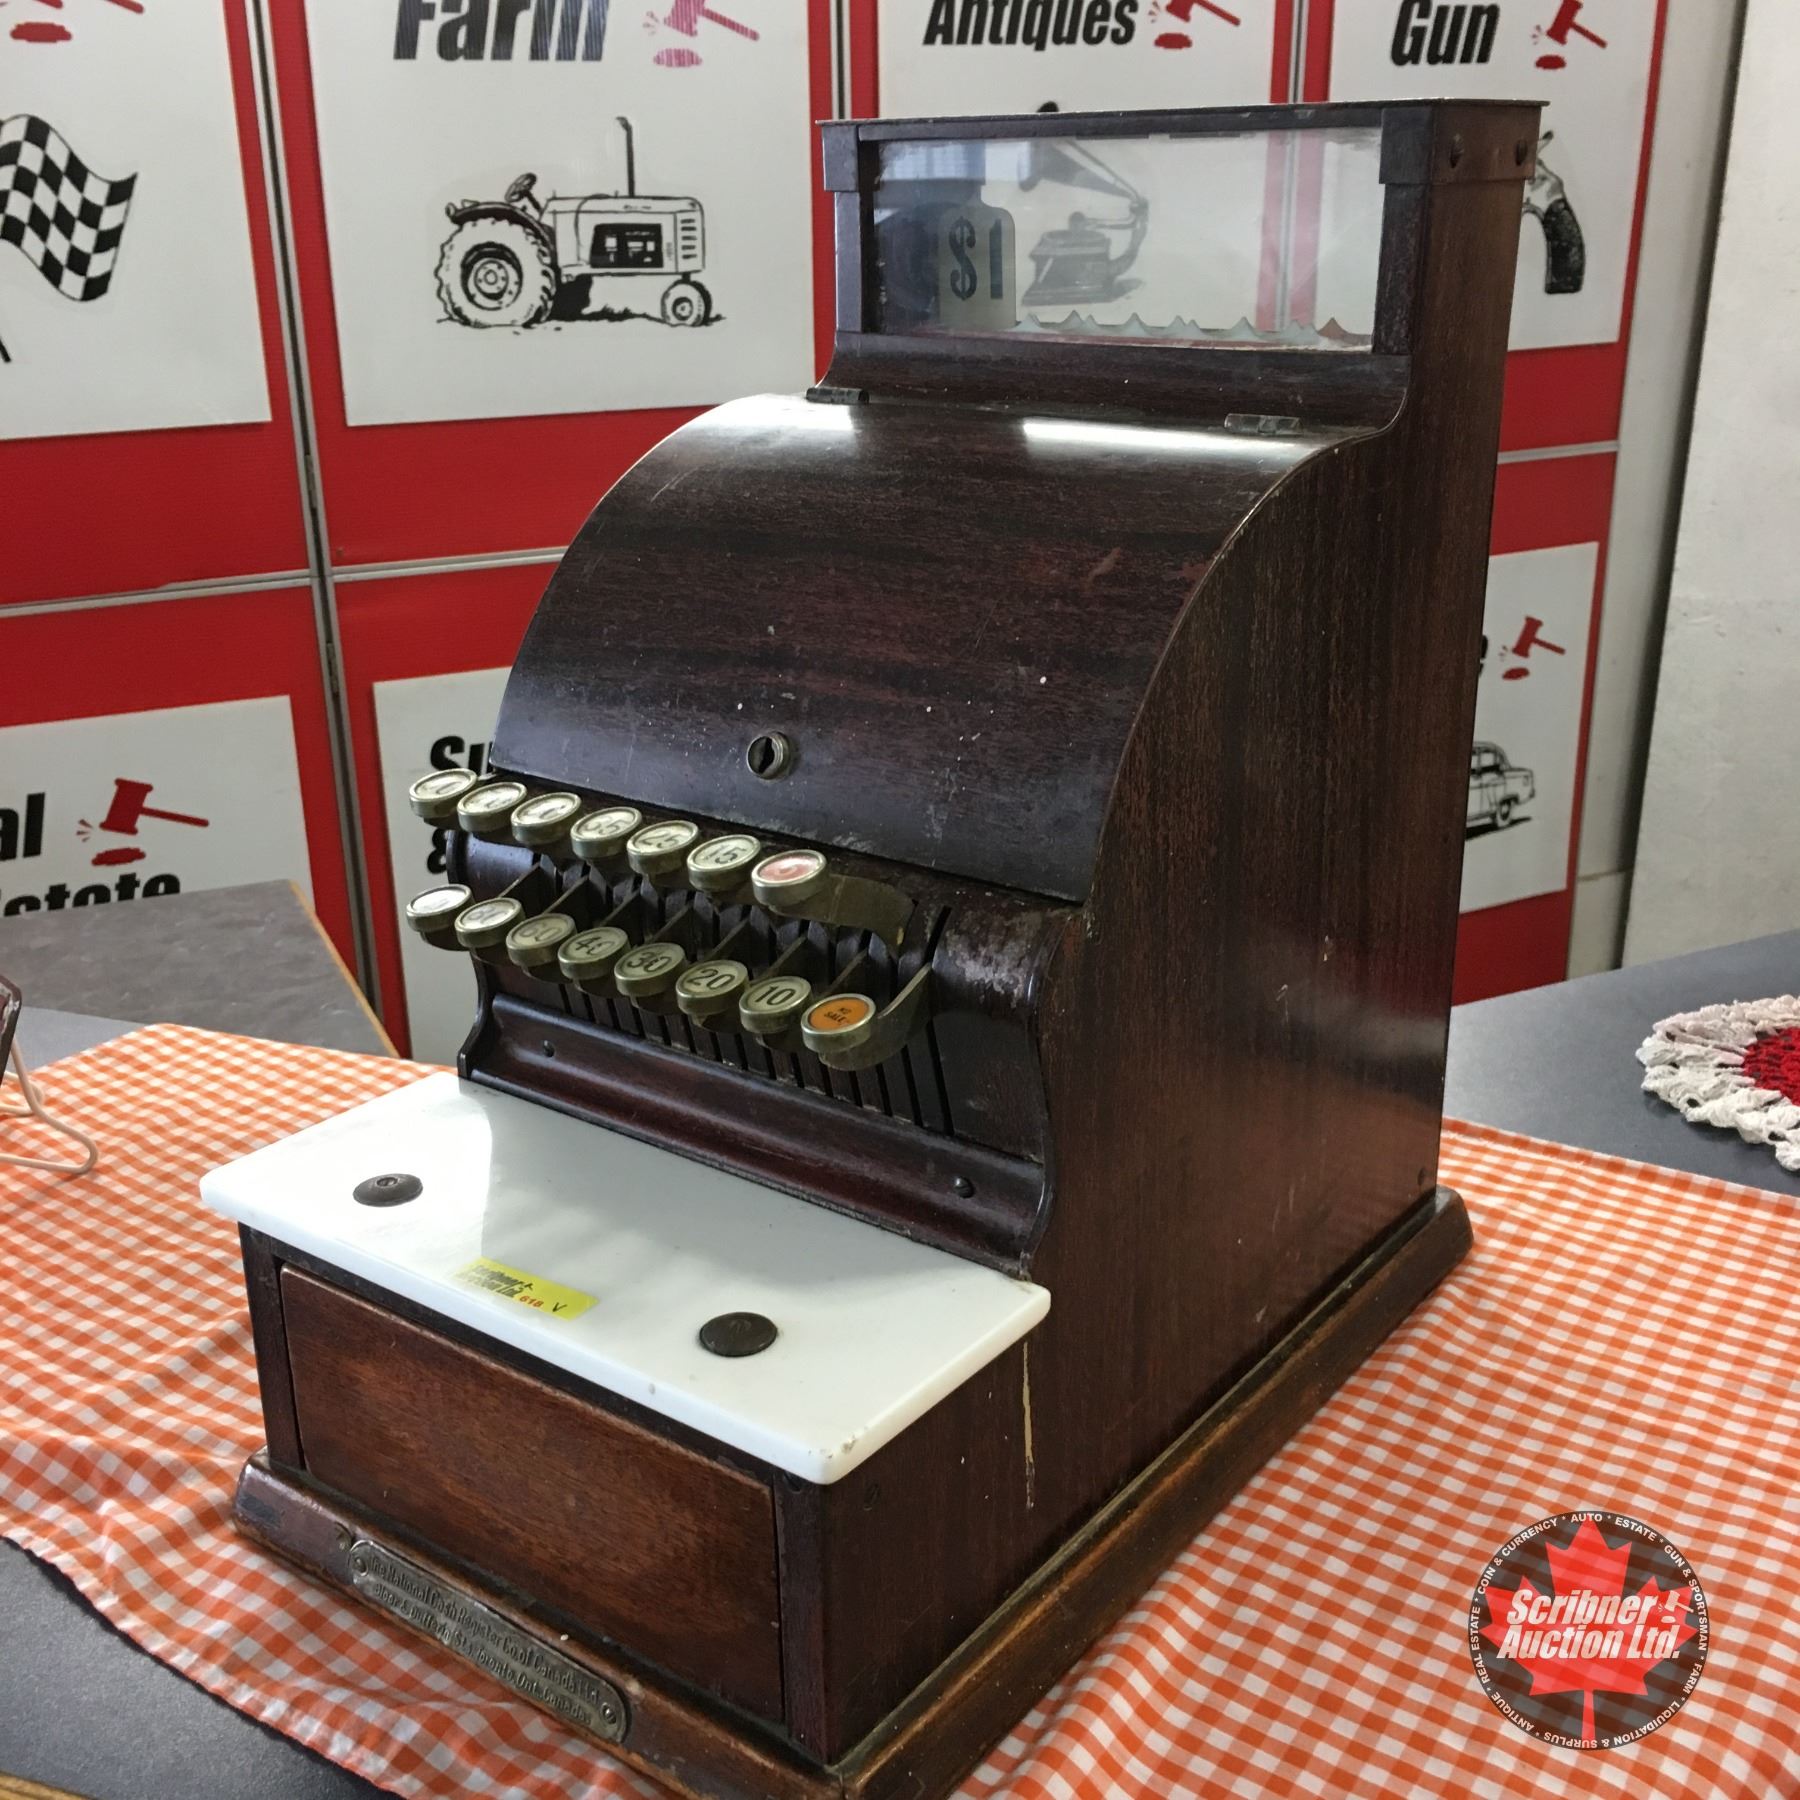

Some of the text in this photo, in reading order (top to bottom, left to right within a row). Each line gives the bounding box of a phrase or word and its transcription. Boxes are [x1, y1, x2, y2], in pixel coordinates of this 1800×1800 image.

[922, 0, 1139, 51] Antiques
[1391, 0, 1501, 66] Gun
[948, 215, 1004, 301] $1
[637, 831, 681, 849] 25
[702, 844, 748, 864] 15
[574, 936, 616, 956] 40
[626, 950, 673, 973] 30
[687, 967, 736, 990] 20
[754, 985, 797, 1006] 10
[387, 1563, 430, 1604] National
[430, 1589, 458, 1621] Cash
[457, 1607, 502, 1647] Register
[534, 1654, 578, 1693] Canada
